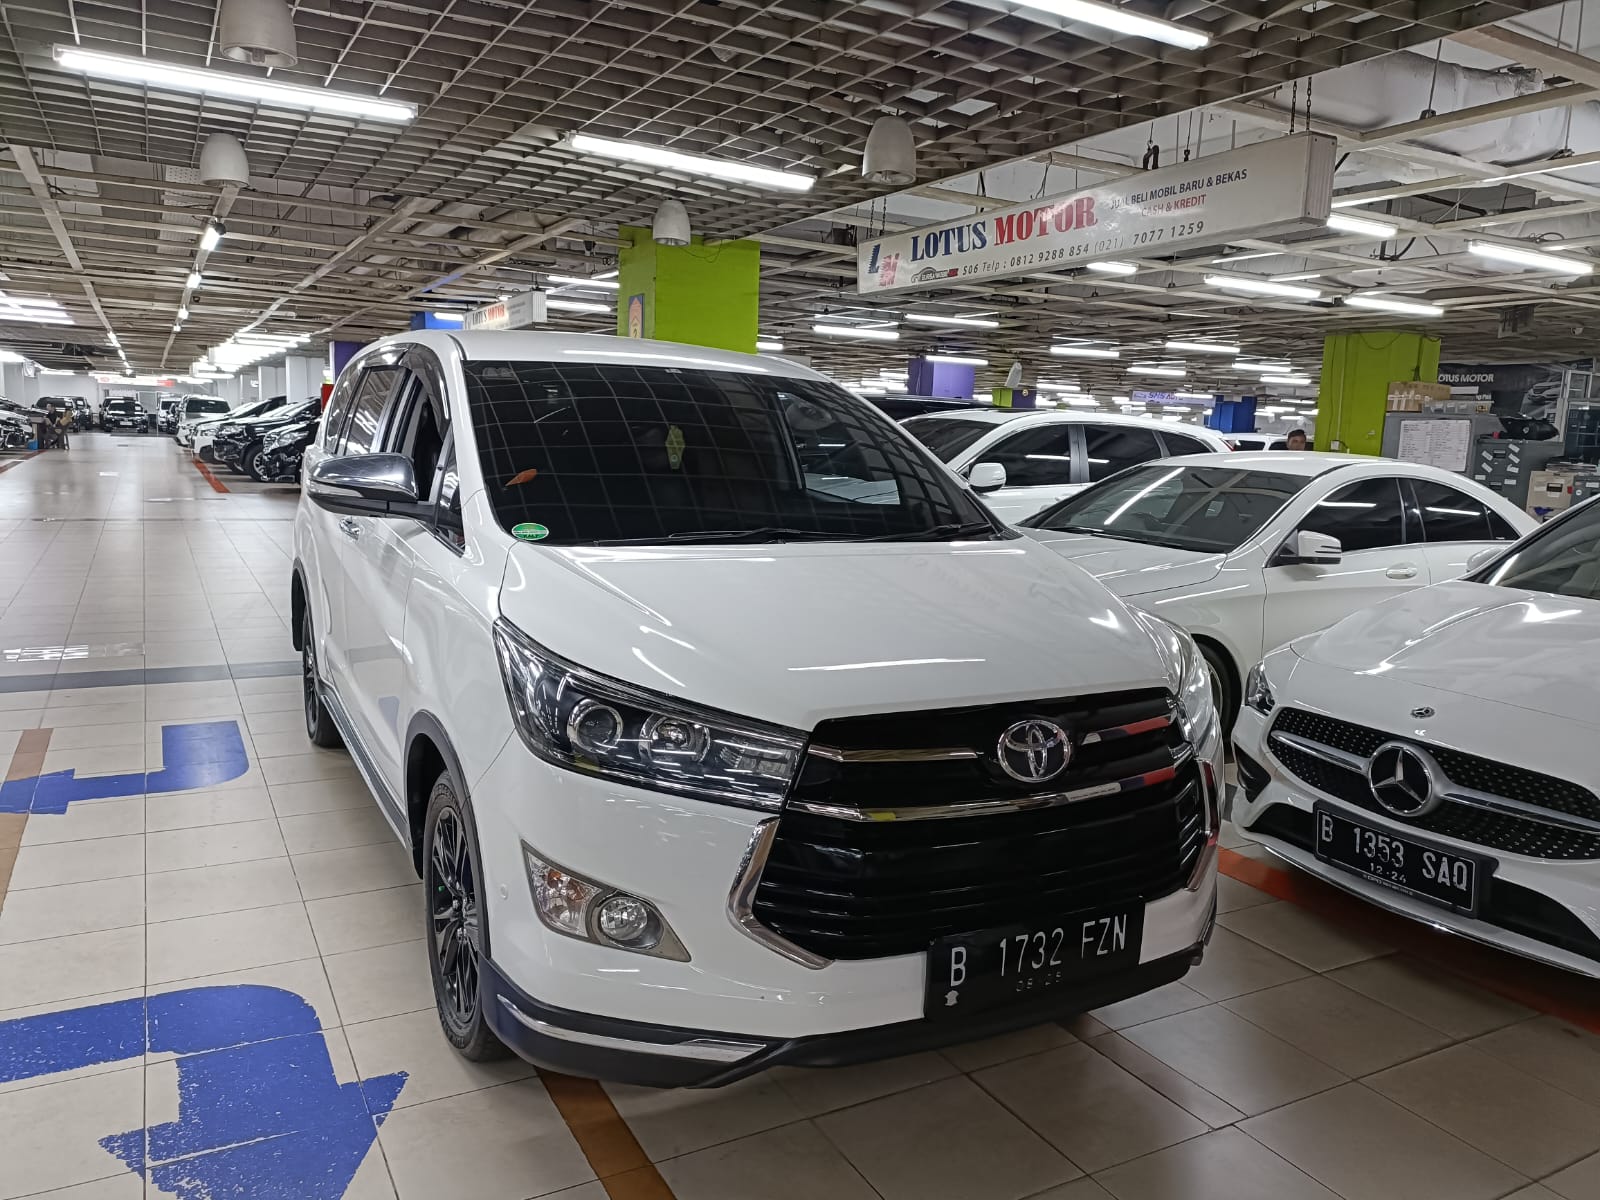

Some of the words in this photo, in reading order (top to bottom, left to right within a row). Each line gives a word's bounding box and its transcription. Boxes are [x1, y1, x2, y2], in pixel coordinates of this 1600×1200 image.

[1131, 190, 1148, 205] BELI
[1149, 185, 1178, 200] MOBIL
[1179, 178, 1205, 194] BARU
[1206, 176, 1213, 187] &
[1215, 168, 1248, 186] BEKAS
[1141, 203, 1164, 217] CASH
[1165, 201, 1172, 212] &
[1173, 194, 1207, 210] KREDIT
[910, 220, 987, 262] LOTUS
[994, 196, 1099, 246] MOTOR
[982, 260, 1000, 273] Telp
[1010, 255, 1034, 267] 0812
[1038, 249, 1064, 263] 9288
[1069, 243, 1089, 257] 854
[1133, 229, 1164, 245] 7077
[1170, 221, 1205, 238] 1259
[1438, 373, 1460, 382] OTUS
[1460, 373, 1494, 383] MOTOR
[1321, 814, 1334, 843] B
[1353, 827, 1405, 868] 1353
[1422, 852, 1468, 892] SAQ
[950, 946, 967, 987] B
[1000, 927, 1065, 977] 1732
[1081, 913, 1127, 959] FZN
